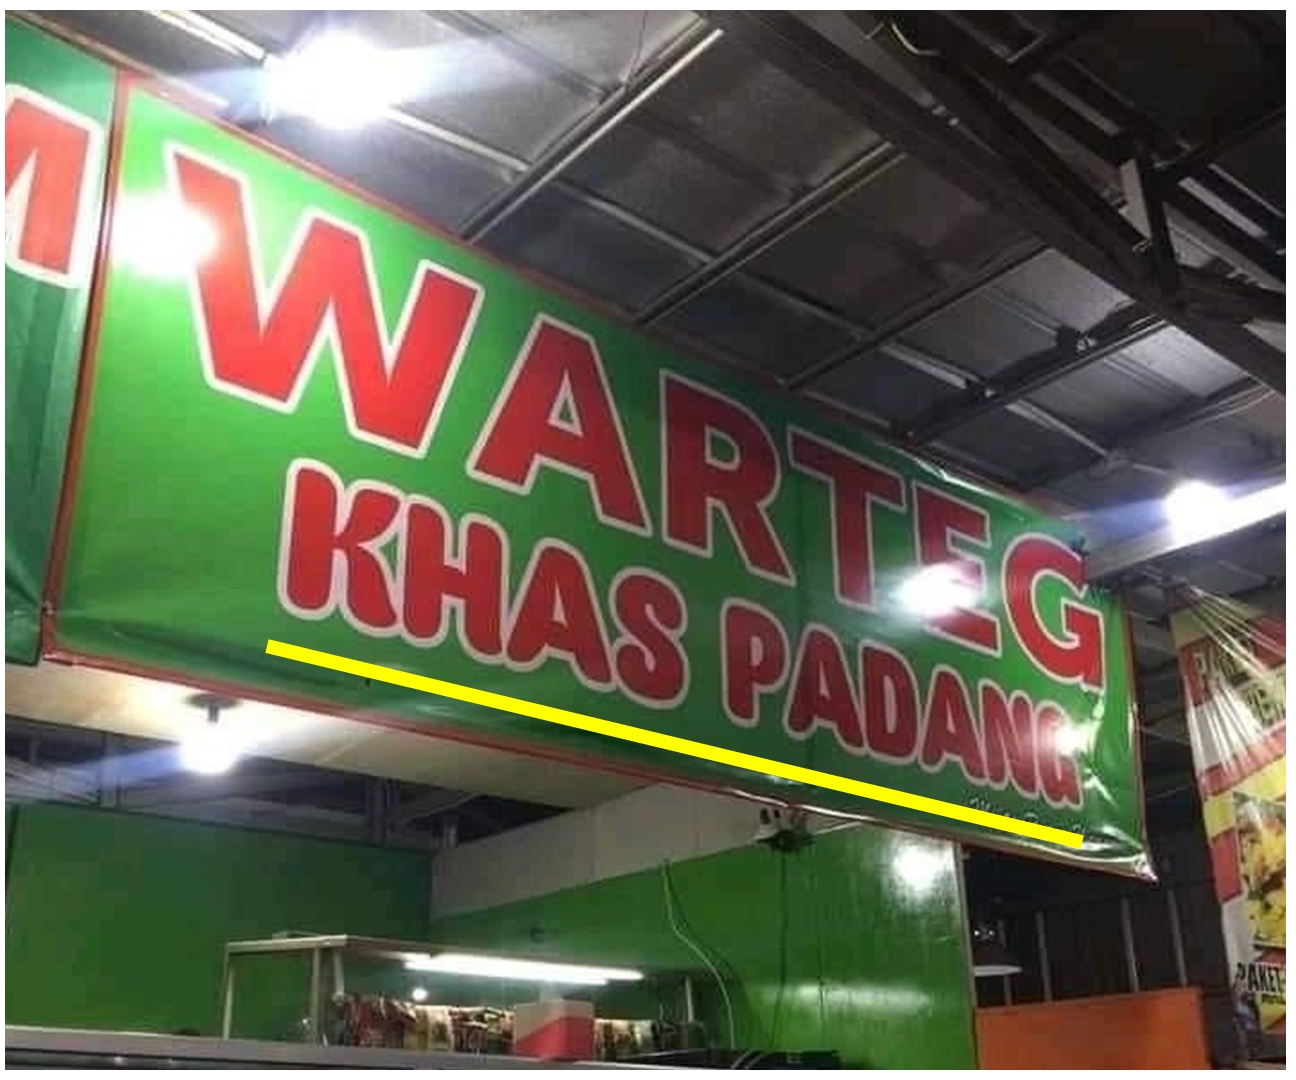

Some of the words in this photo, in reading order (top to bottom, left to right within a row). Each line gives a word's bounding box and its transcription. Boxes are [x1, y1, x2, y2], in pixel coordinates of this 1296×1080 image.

[164, 140, 1105, 692] WARTEG
[277, 458, 690, 708] KHAS
[720, 599, 1083, 812] PADANG
